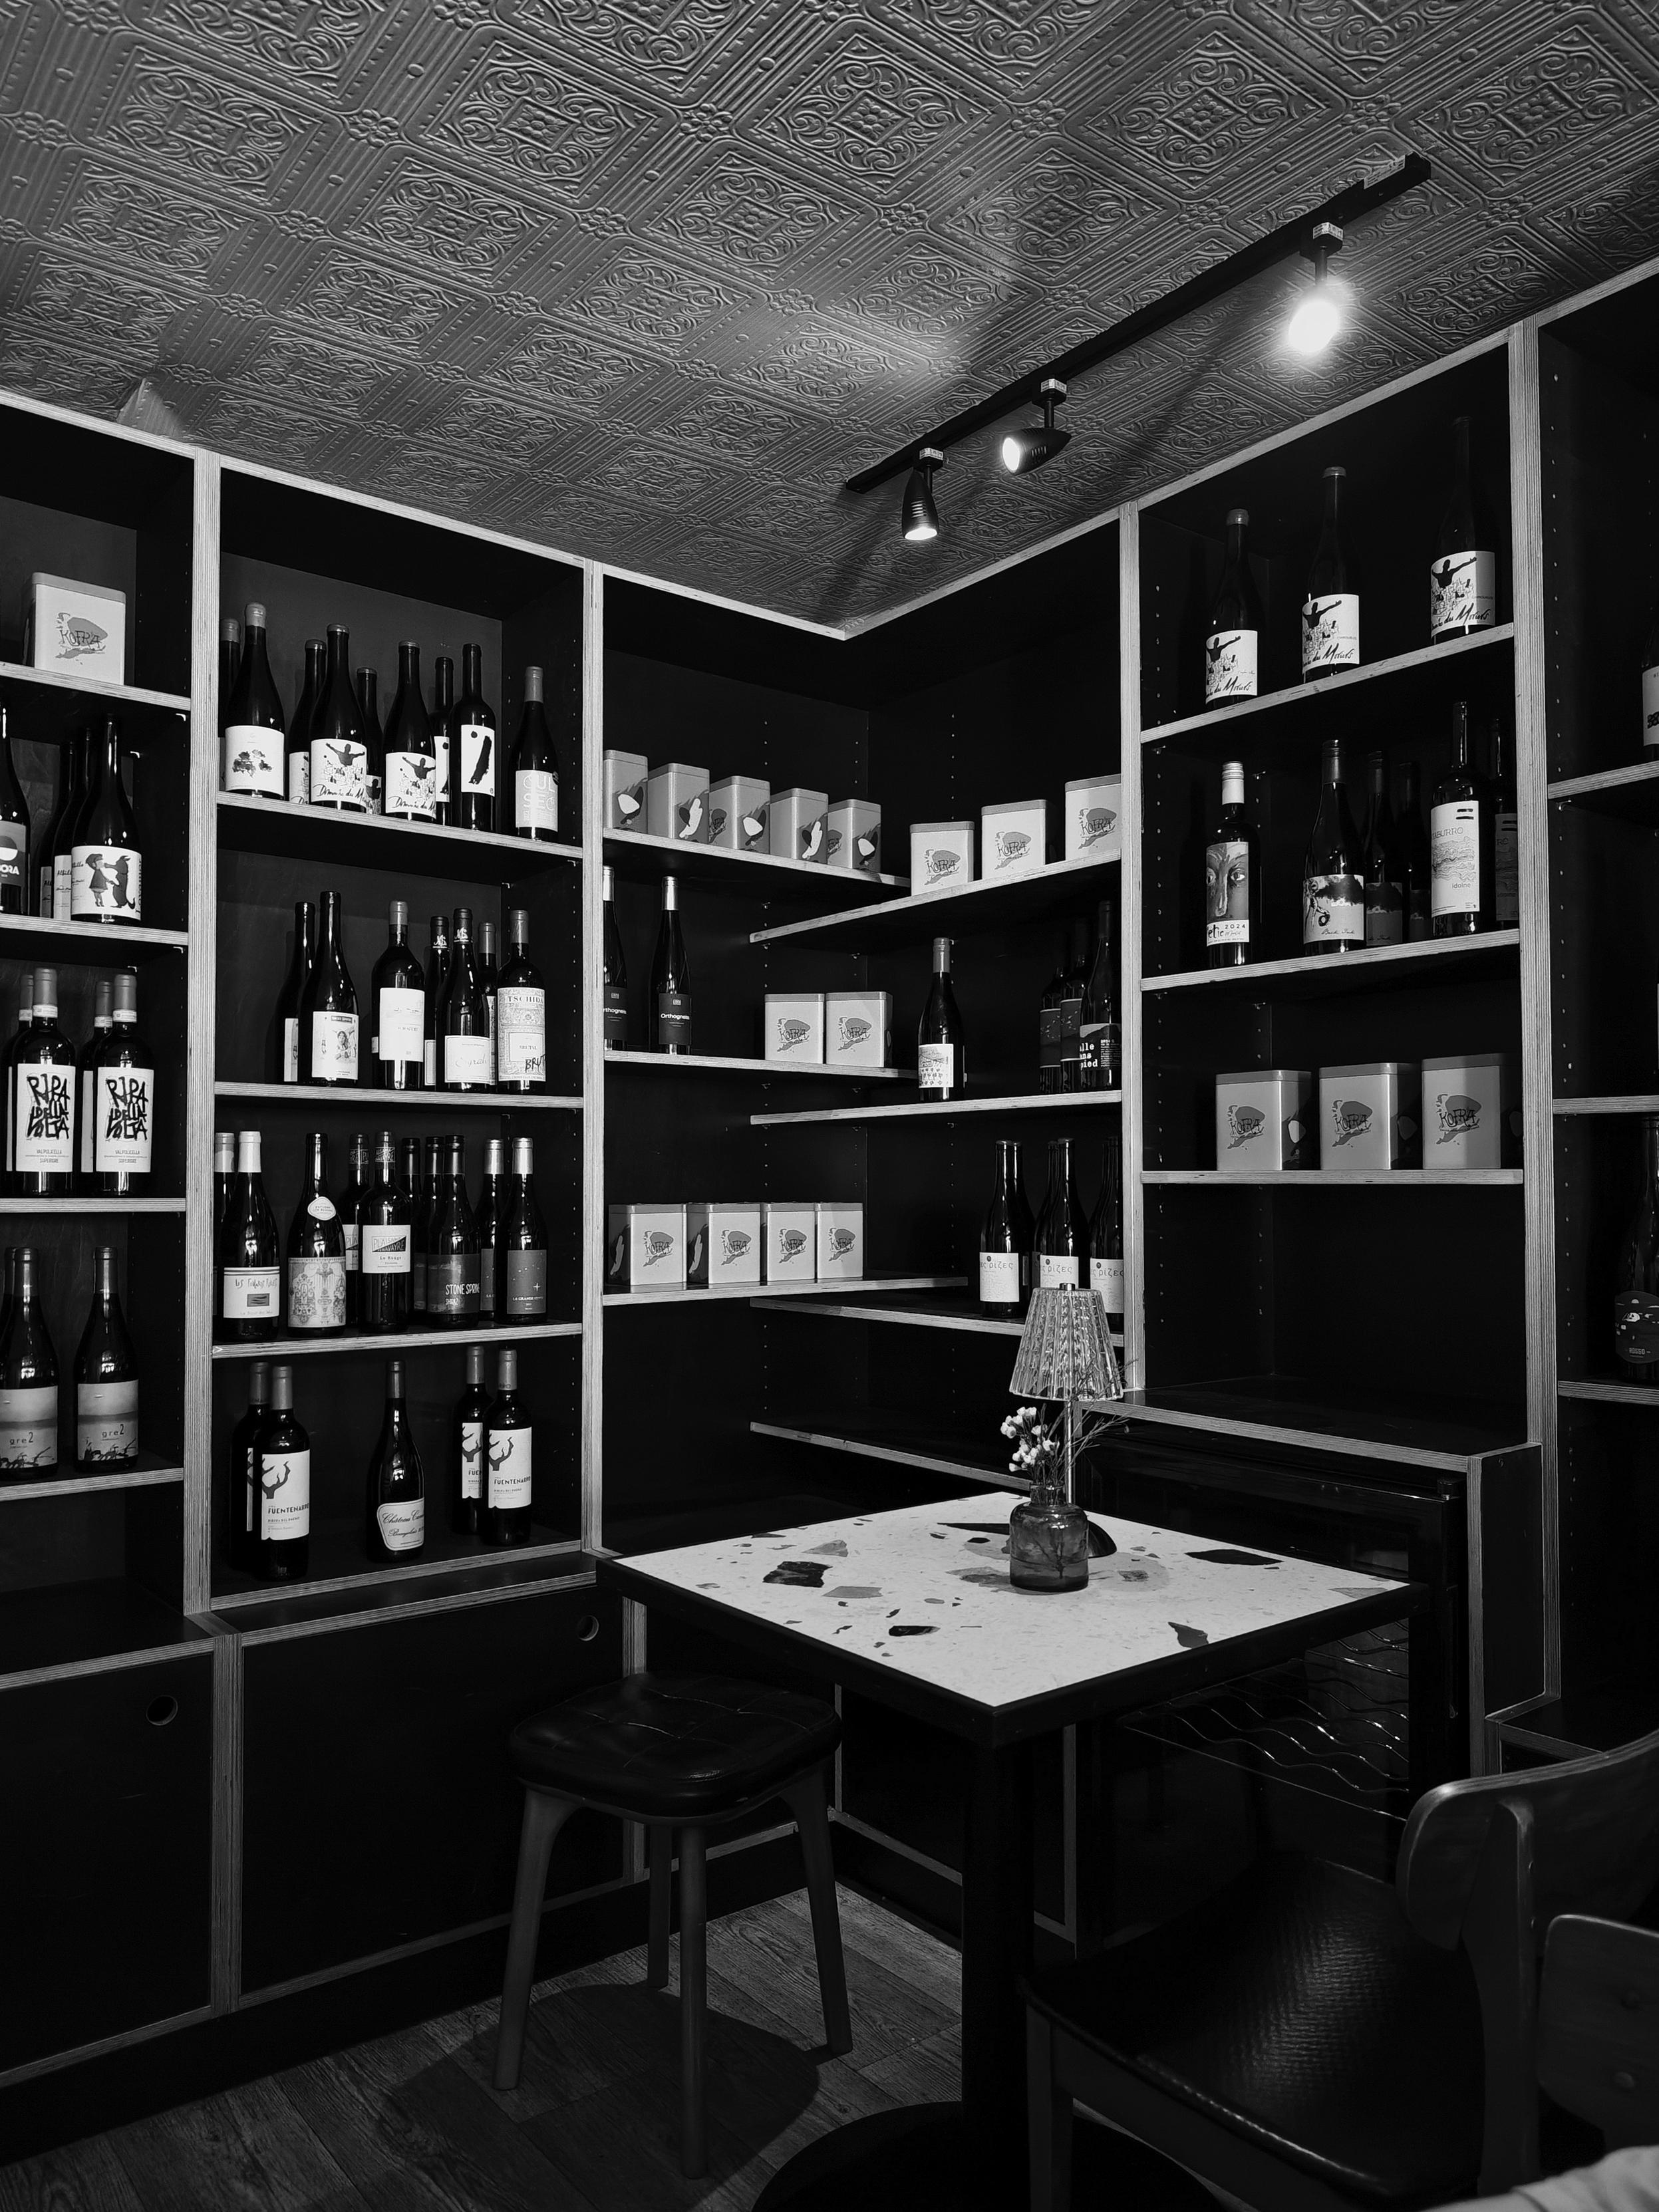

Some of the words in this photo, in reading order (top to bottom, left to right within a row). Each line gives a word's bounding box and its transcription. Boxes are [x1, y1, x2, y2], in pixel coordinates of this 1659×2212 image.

[59, 629, 102, 650] KOFRA
[0, 864, 20, 875] ORA
[1230, 1118, 1261, 1135] KOFRA
[1335, 1113, 1368, 1130] KOFRA
[1439, 1109, 1475, 1128] KOFRA
[445, 1284, 465, 1296] STONE
